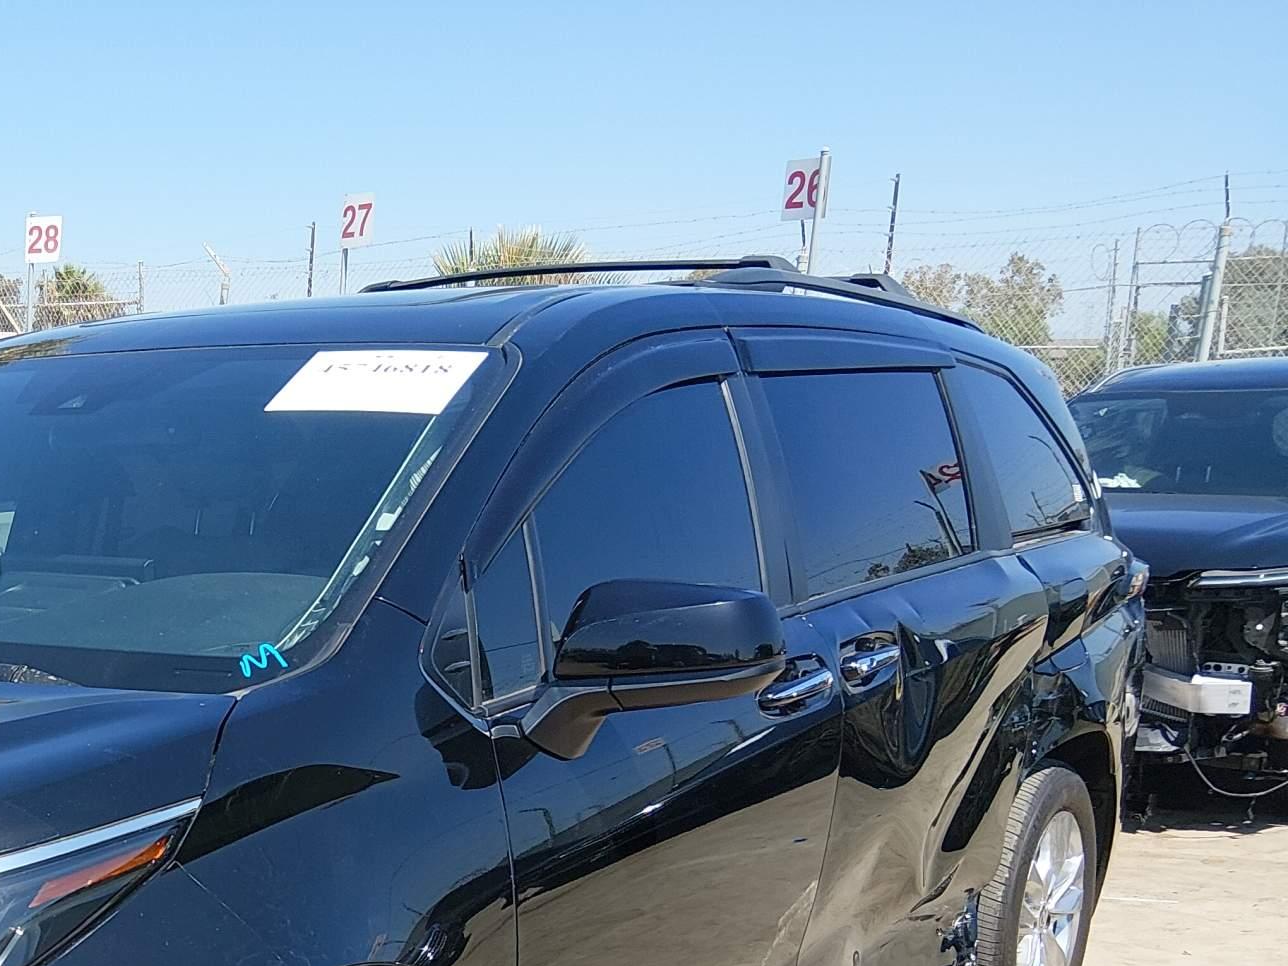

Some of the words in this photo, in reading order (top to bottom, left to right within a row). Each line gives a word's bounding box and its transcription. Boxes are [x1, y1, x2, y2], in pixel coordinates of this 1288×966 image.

[784, 168, 821, 210] 26
[27, 224, 60, 255] 28
[340, 202, 373, 240] 27
